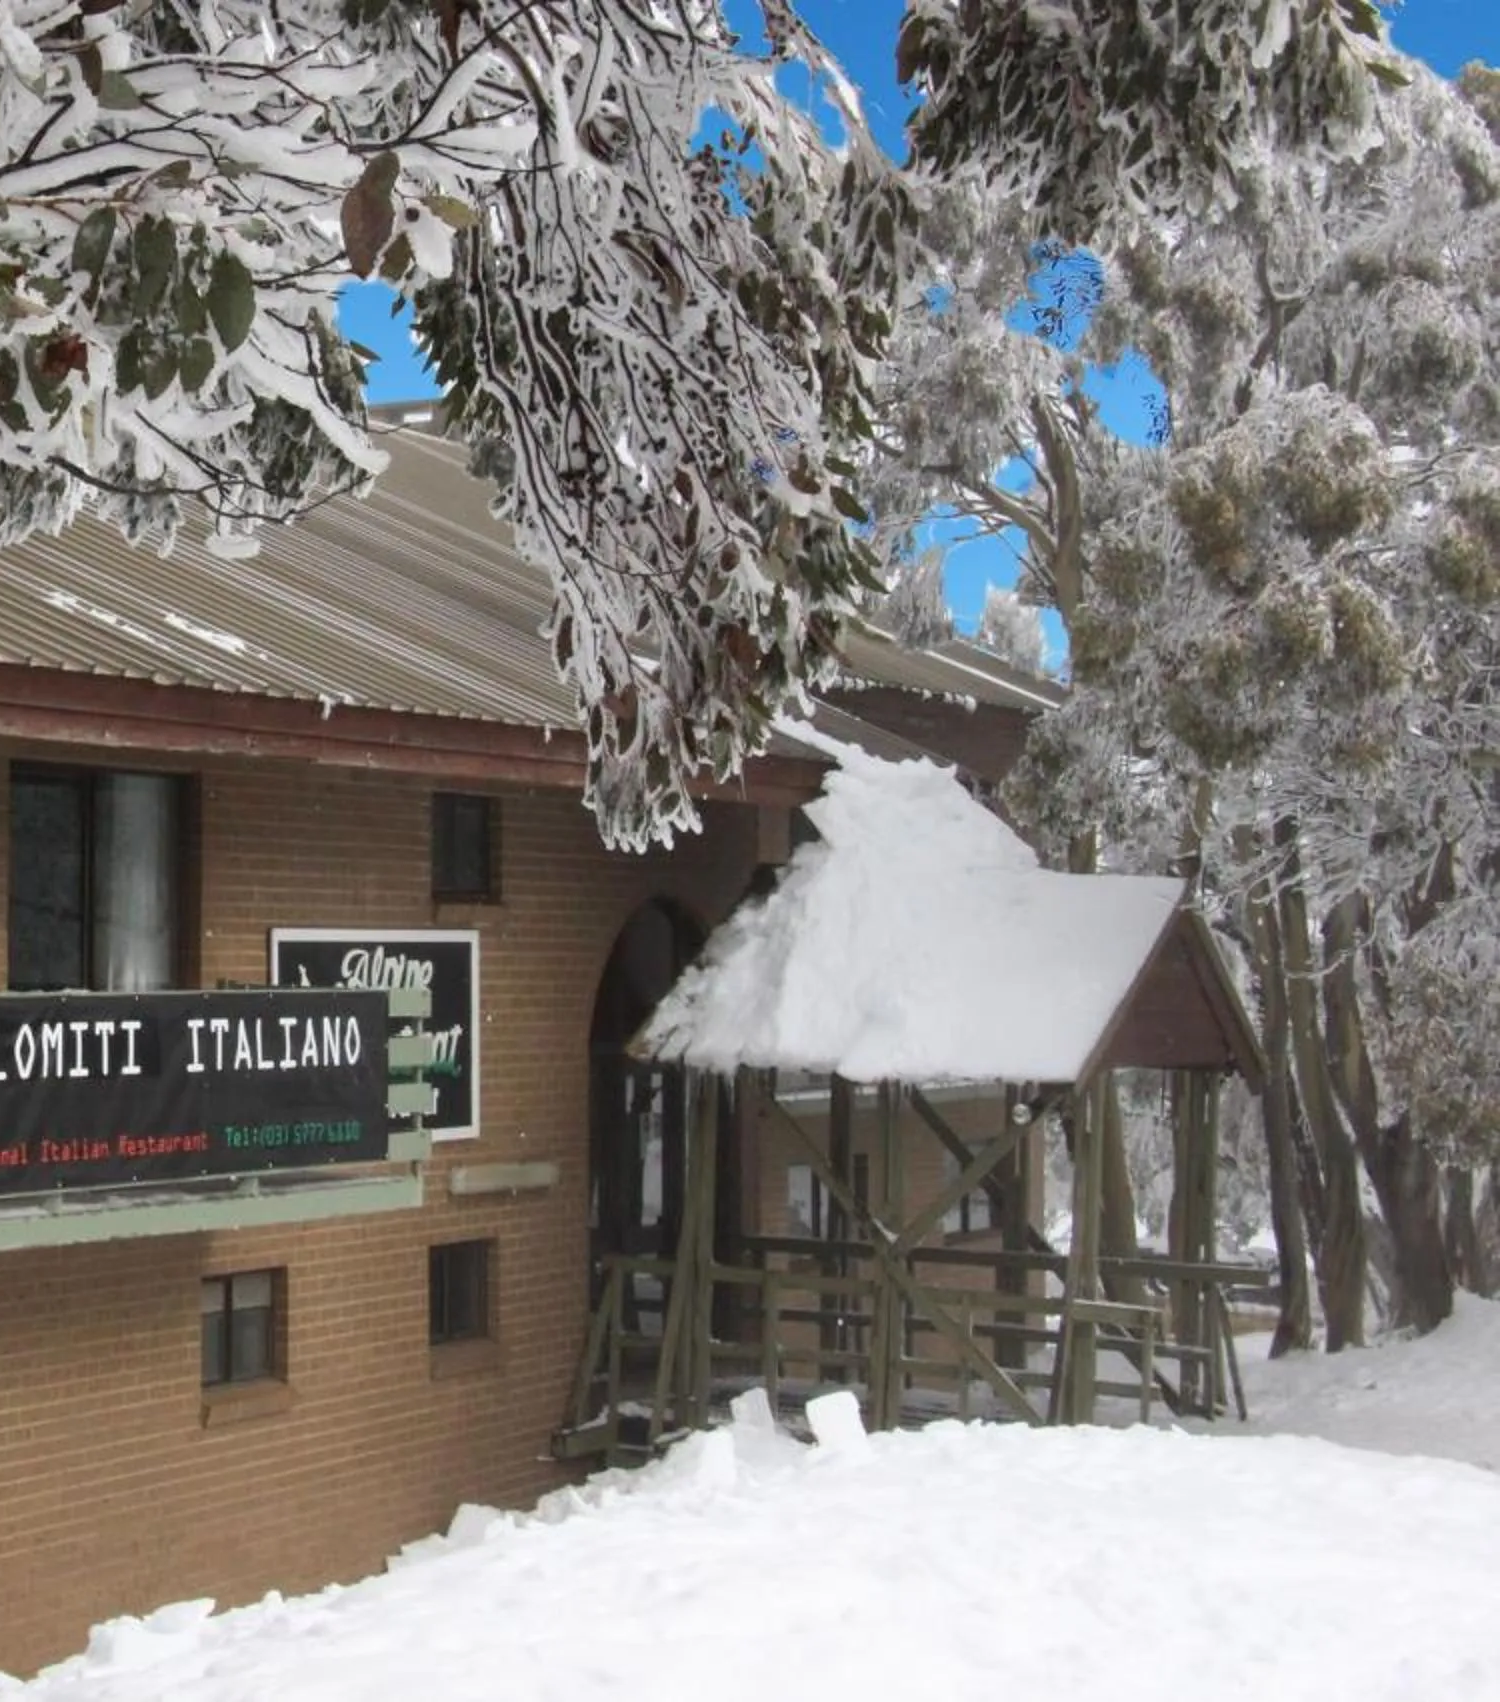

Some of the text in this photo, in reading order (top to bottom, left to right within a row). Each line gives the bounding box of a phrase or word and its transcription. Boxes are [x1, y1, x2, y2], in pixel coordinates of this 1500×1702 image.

[187, 1016, 362, 1073] ITALIANO
[40, 1136, 110, 1163] Italian
[118, 1131, 208, 1157] Restaurant
